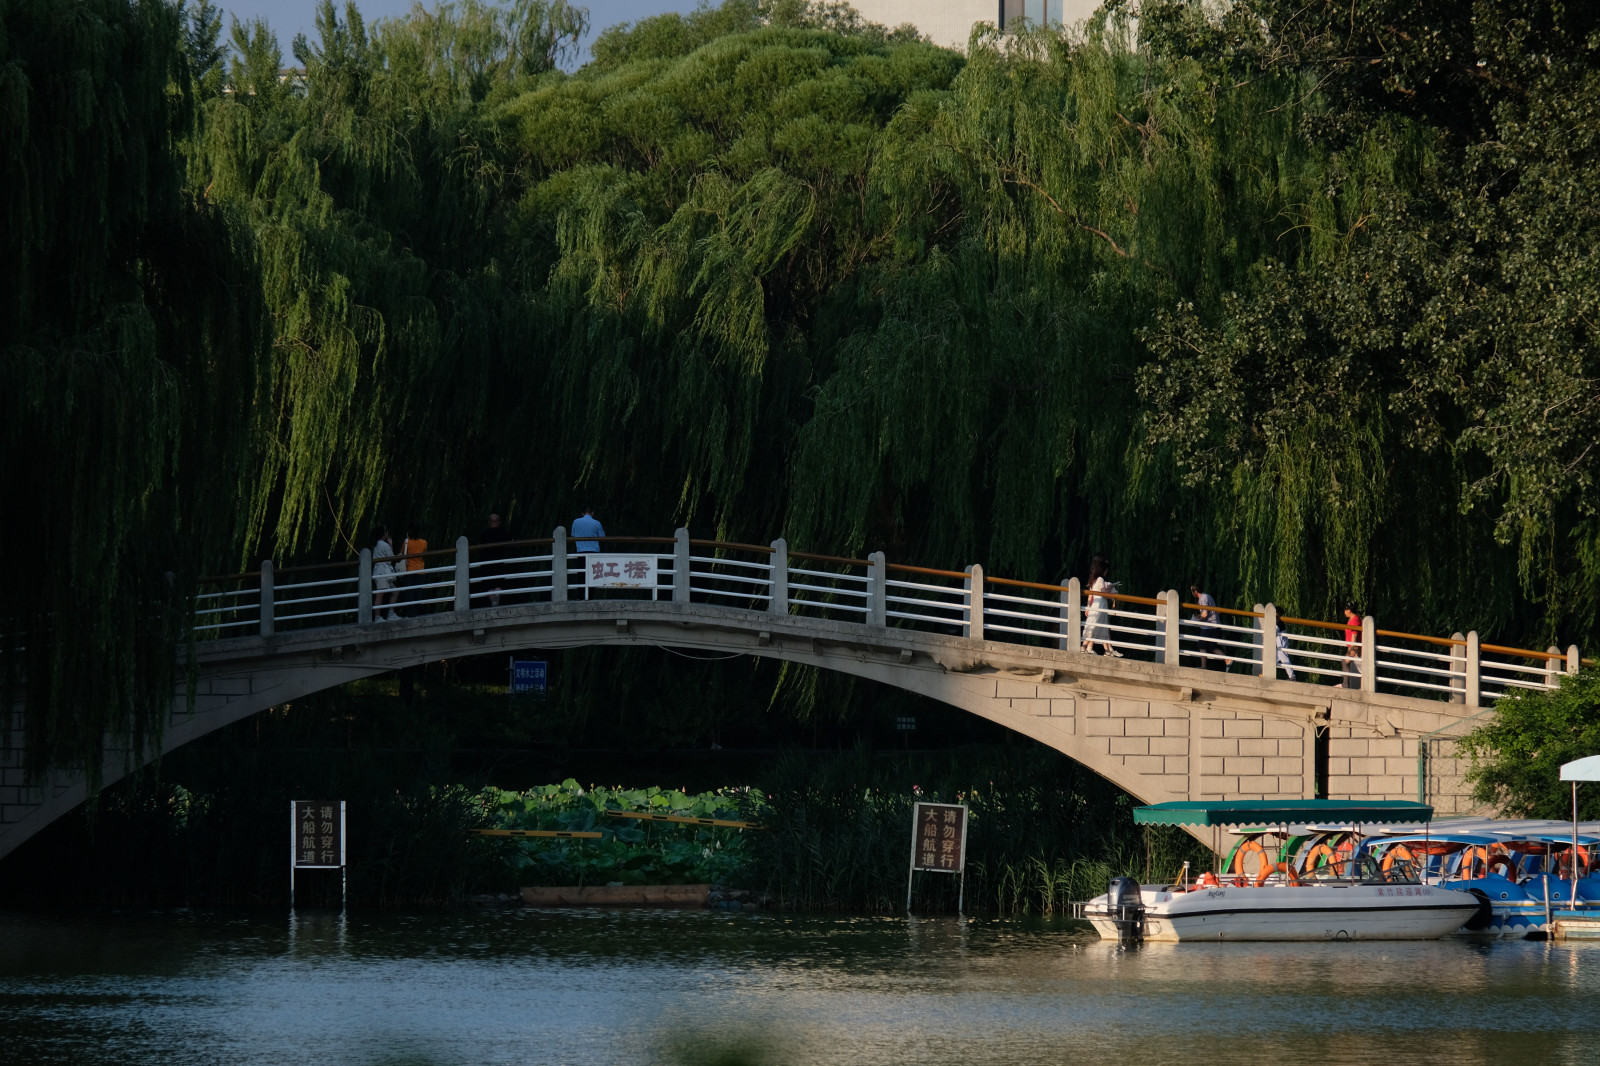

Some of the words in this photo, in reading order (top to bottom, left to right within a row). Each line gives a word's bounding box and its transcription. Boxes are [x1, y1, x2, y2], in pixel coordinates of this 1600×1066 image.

[302, 806, 316, 863] 大船航道
[320, 806, 334, 863] 请勿穿行
[921, 809, 938, 866] 大船航道
[940, 810, 957, 868] 请勿穿行
